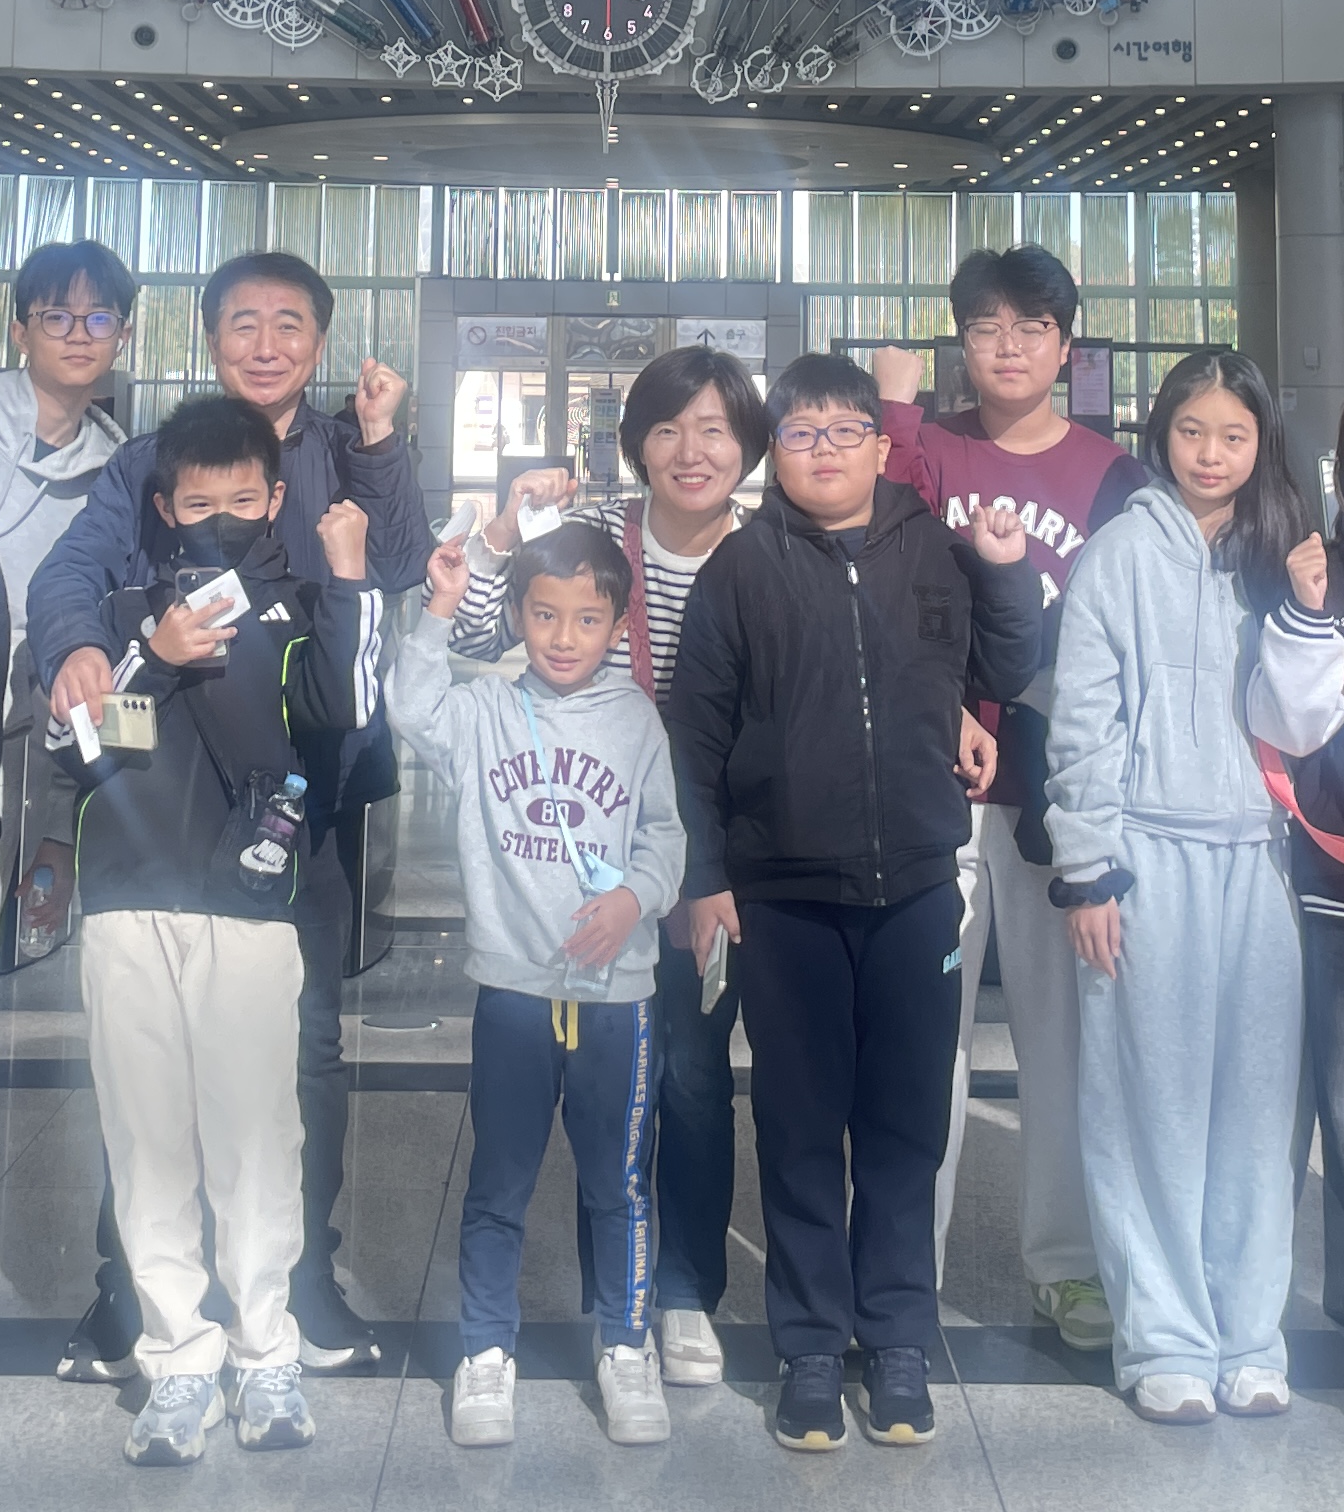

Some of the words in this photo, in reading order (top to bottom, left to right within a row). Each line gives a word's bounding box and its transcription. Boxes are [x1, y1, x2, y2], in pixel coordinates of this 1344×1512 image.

[563, 3, 572, 18] 8
[644, 5, 653, 18] 4
[581, 20, 590, 34] 7
[603, 27, 613, 41] 6
[627, 20, 636, 35] 5
[1113, 39, 1193, 64] 시간여행
[495, 326, 537, 338] 진입금지
[726, 328, 746, 340] 출구
[500, 829, 558, 863] STATE
